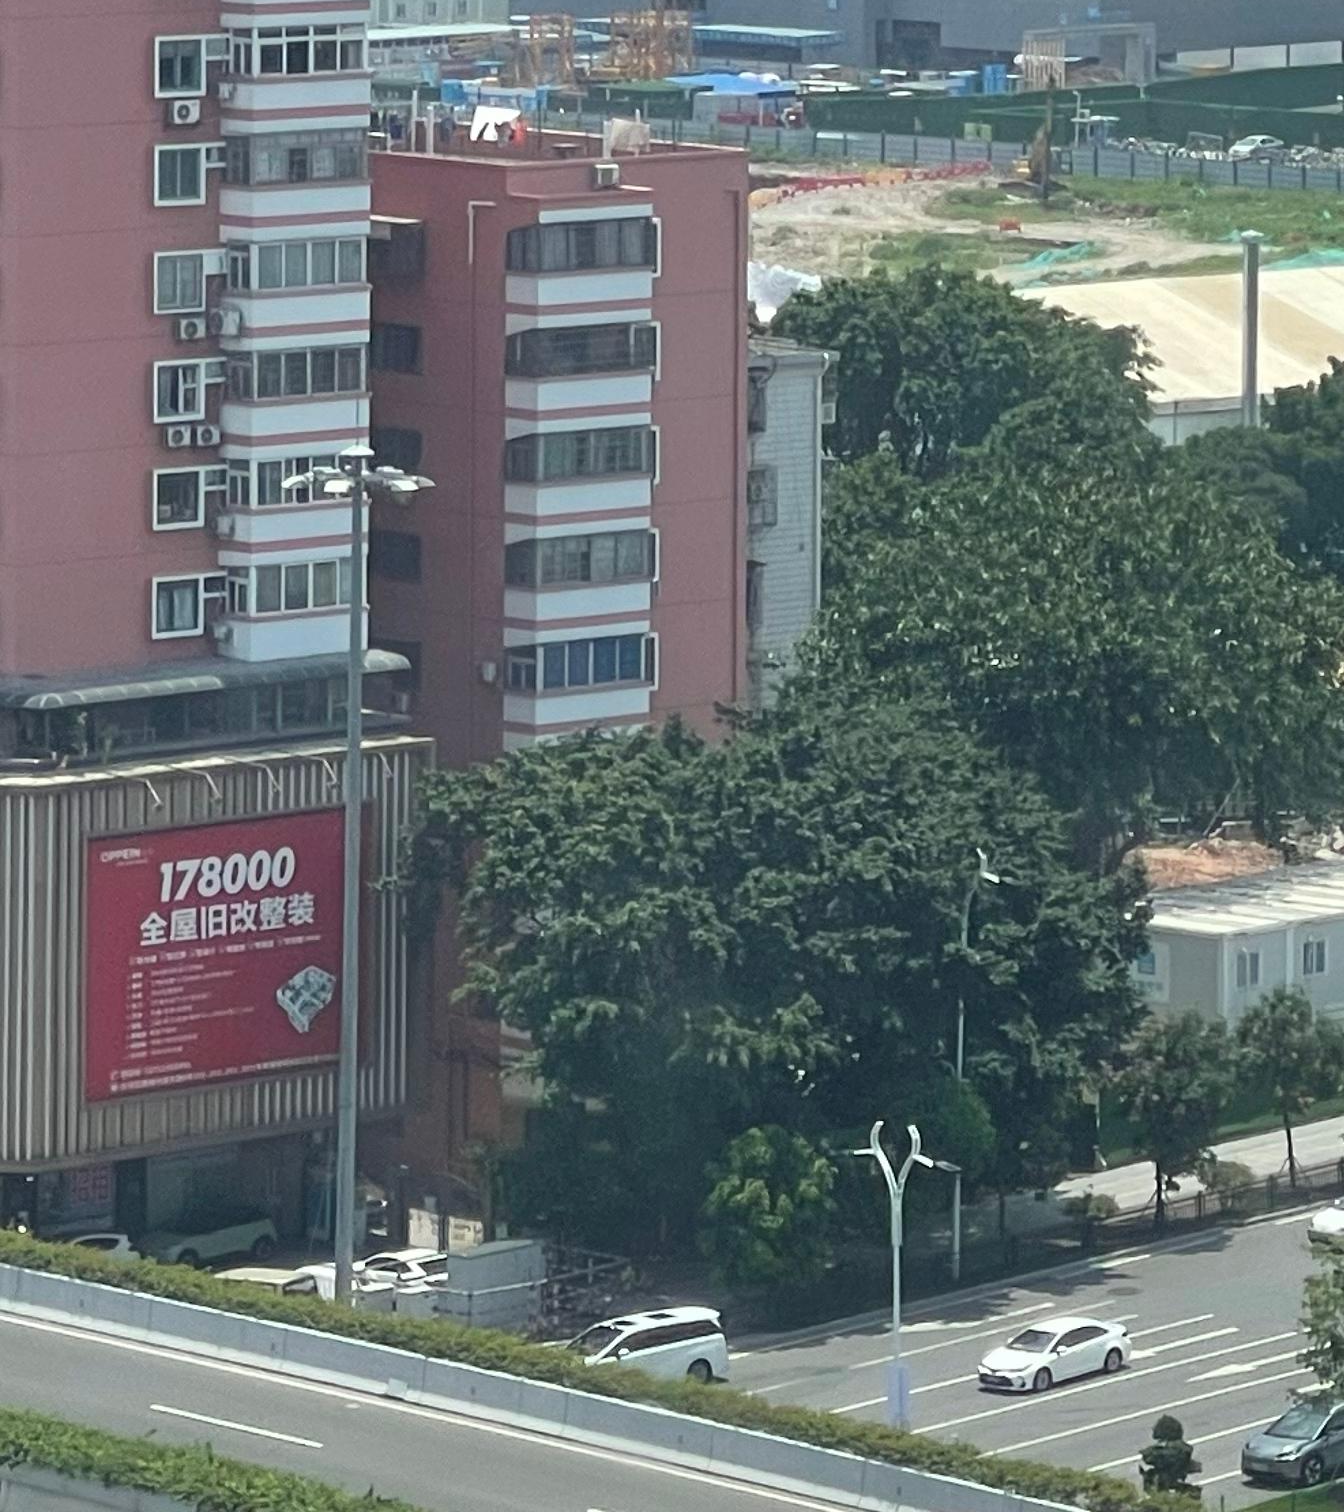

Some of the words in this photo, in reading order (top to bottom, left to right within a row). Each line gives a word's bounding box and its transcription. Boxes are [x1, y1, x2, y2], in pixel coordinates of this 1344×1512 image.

[159, 846, 296, 903] 178000
[139, 892, 316, 947] 全屋旧改整装
